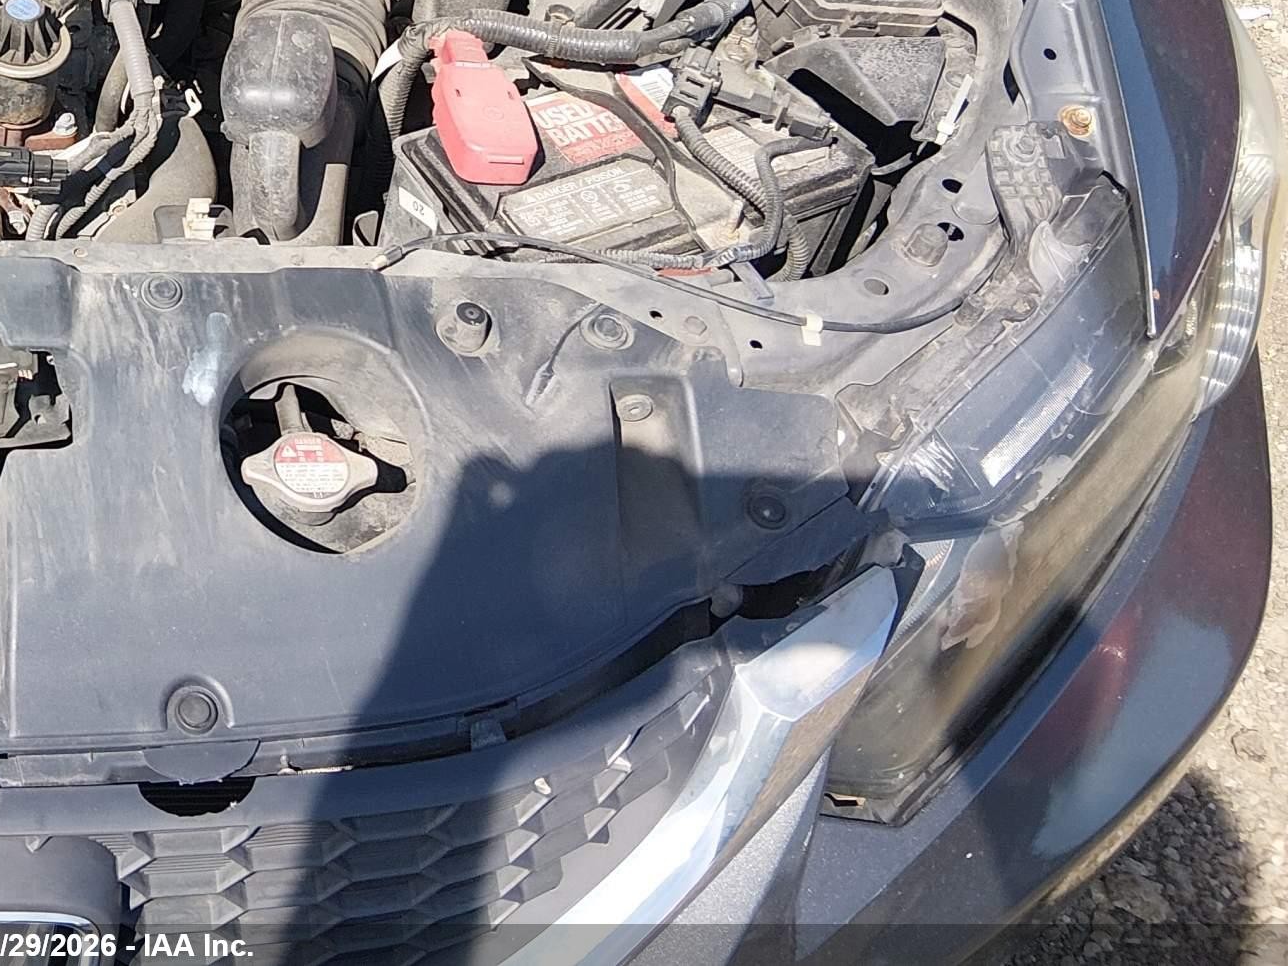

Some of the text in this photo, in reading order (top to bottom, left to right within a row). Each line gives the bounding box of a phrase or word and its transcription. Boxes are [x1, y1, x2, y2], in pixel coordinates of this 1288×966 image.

[536, 100, 593, 129] USED
[536, 179, 577, 202] DANGER
[585, 167, 625, 186] POISON
